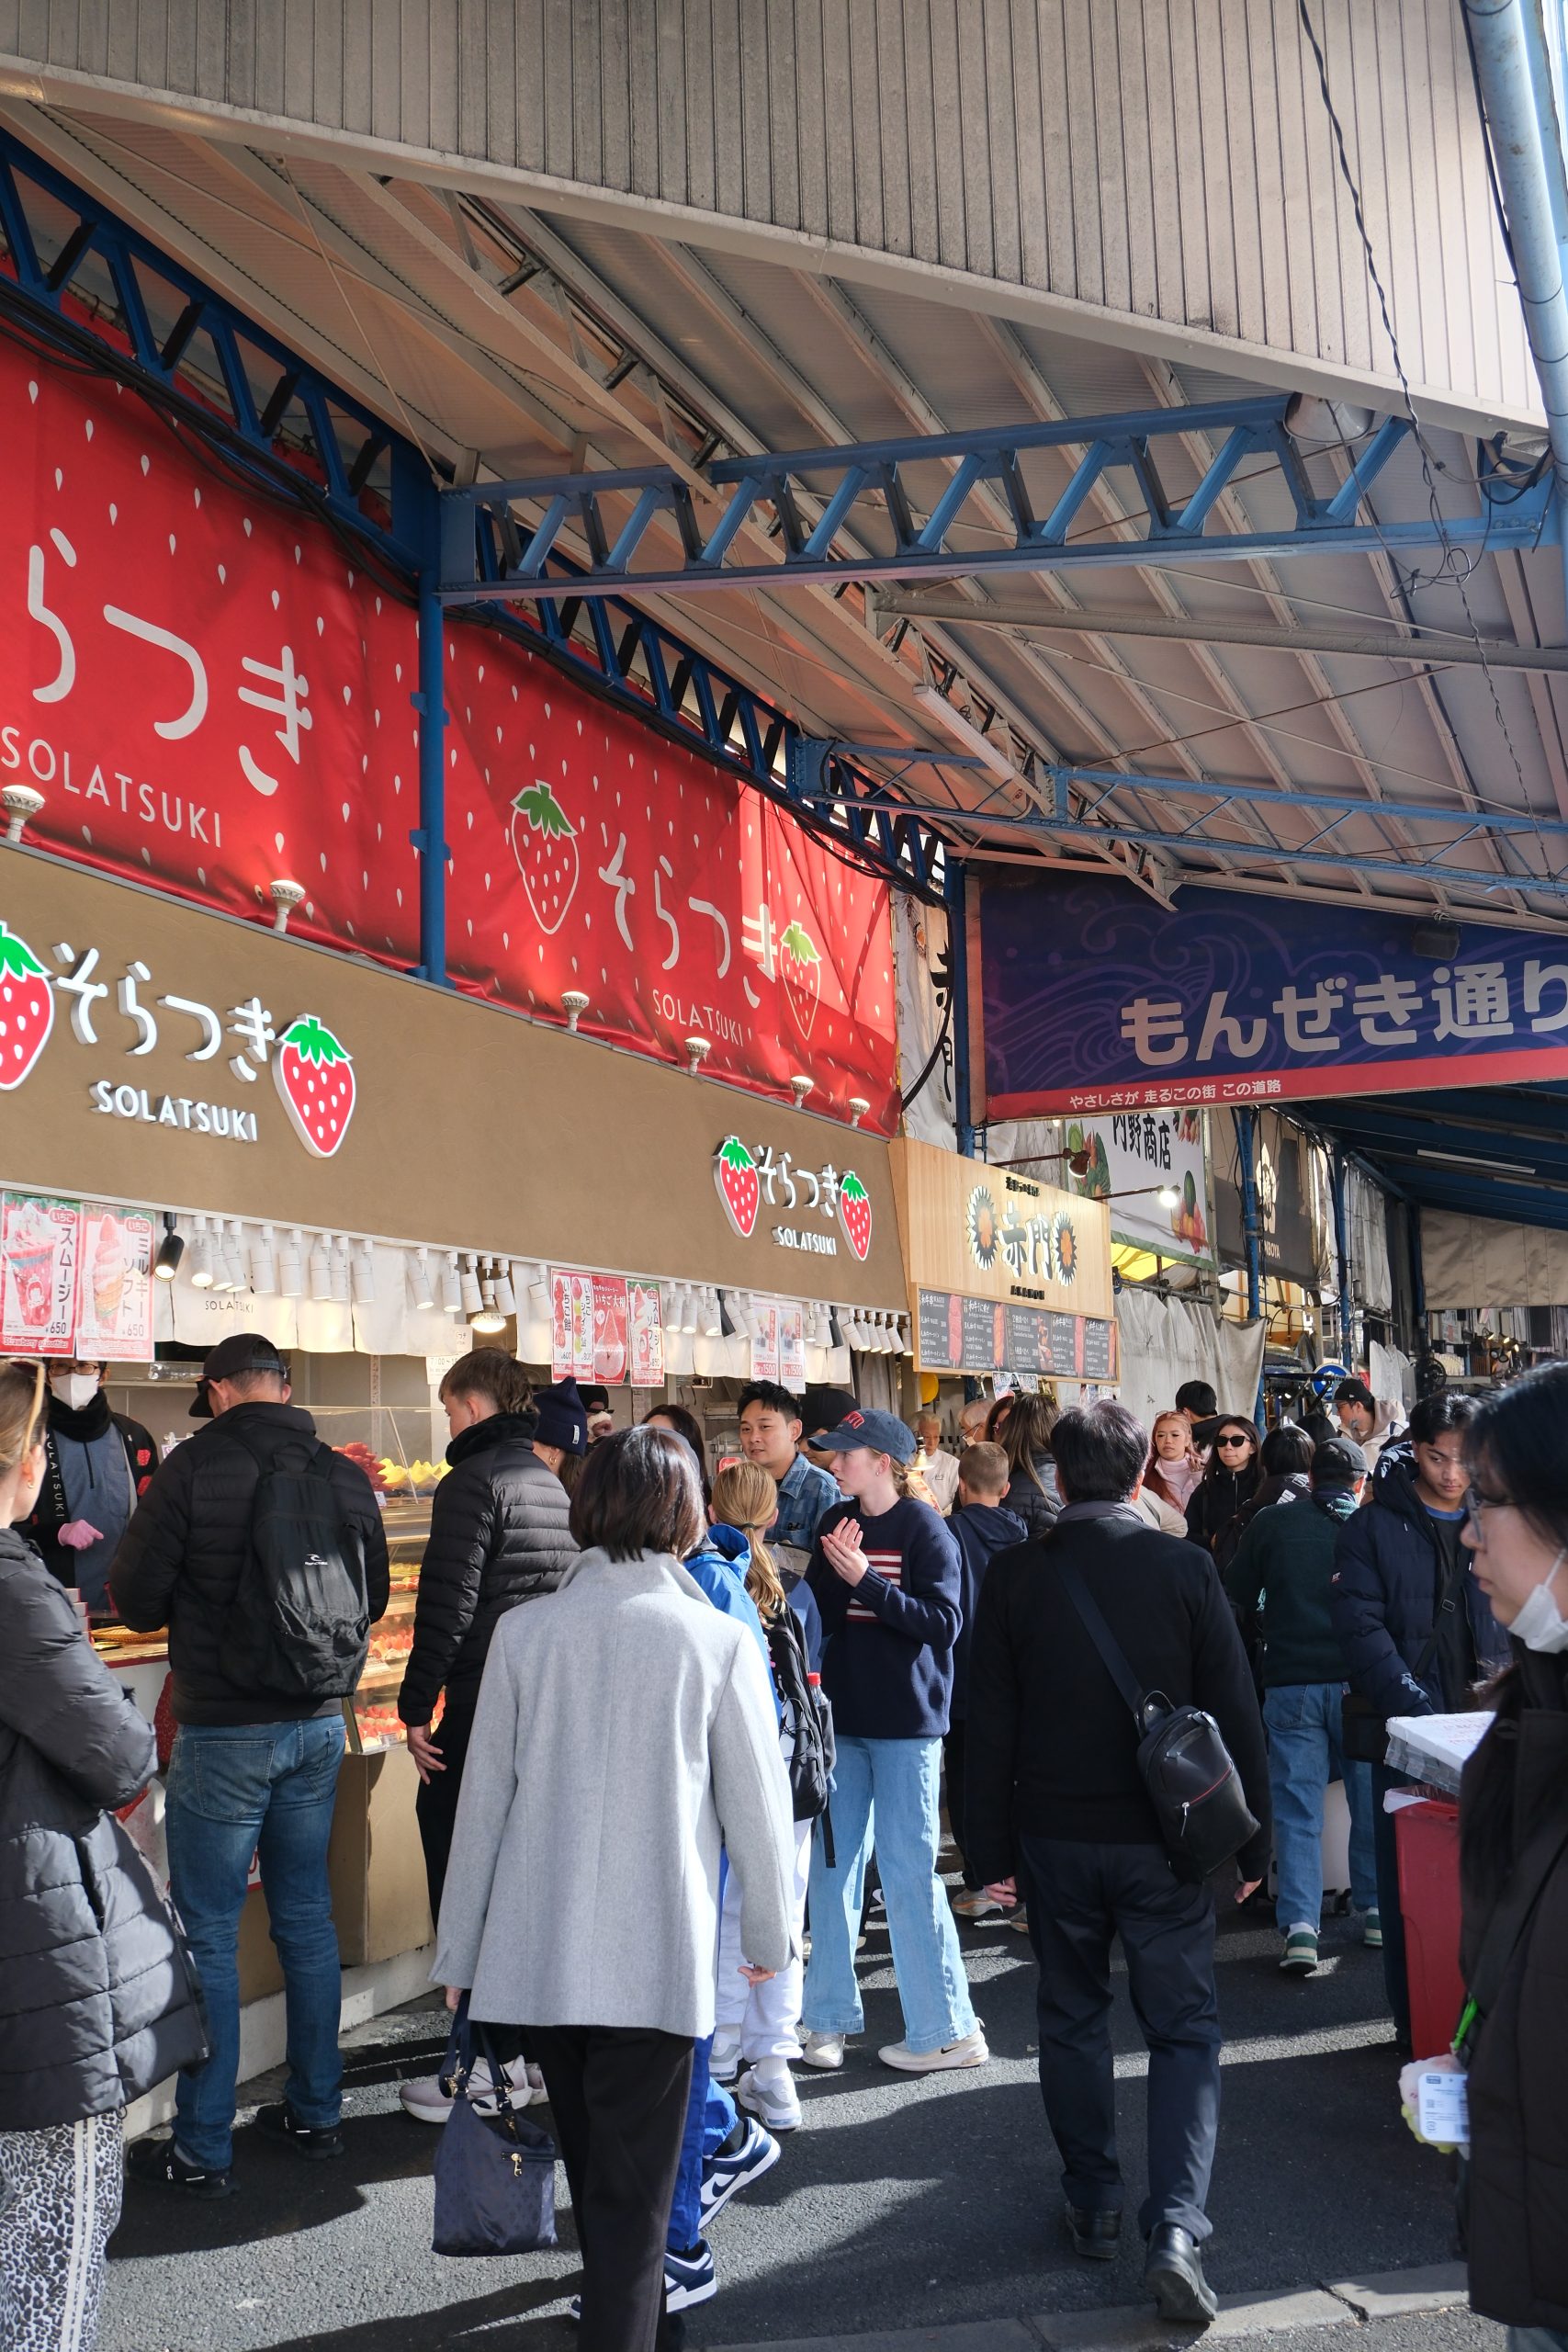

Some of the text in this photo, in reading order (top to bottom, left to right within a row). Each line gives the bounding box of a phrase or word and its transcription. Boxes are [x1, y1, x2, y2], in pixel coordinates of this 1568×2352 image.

[1, 726, 222, 848] SOLATSUKI
[597, 821, 779, 1010] そらつき
[52, 942, 276, 1082] そらつき
[651, 989, 744, 1047] SOLATSUKI
[1120, 958, 1568, 1068] もんぜき通り
[90, 1080, 259, 1143] SOLATSUKI
[1069, 1090, 1140, 1110] やさしさが
[1223, 1079, 1282, 1099] この道路
[1112, 1113, 1171, 1170] 内野商店
[751, 1145, 840, 1218] そらつき
[51, 1209, 75, 1224] いちご
[127, 1218, 150, 1233] いちご
[772, 1226, 838, 1256] SOLATSUKI
[997, 1200, 1054, 1281] 赤門
[59, 1227, 73, 1320] スムージー
[122, 1257, 136, 1317] ソフト
[135, 1237, 150, 1319] ミルキー
